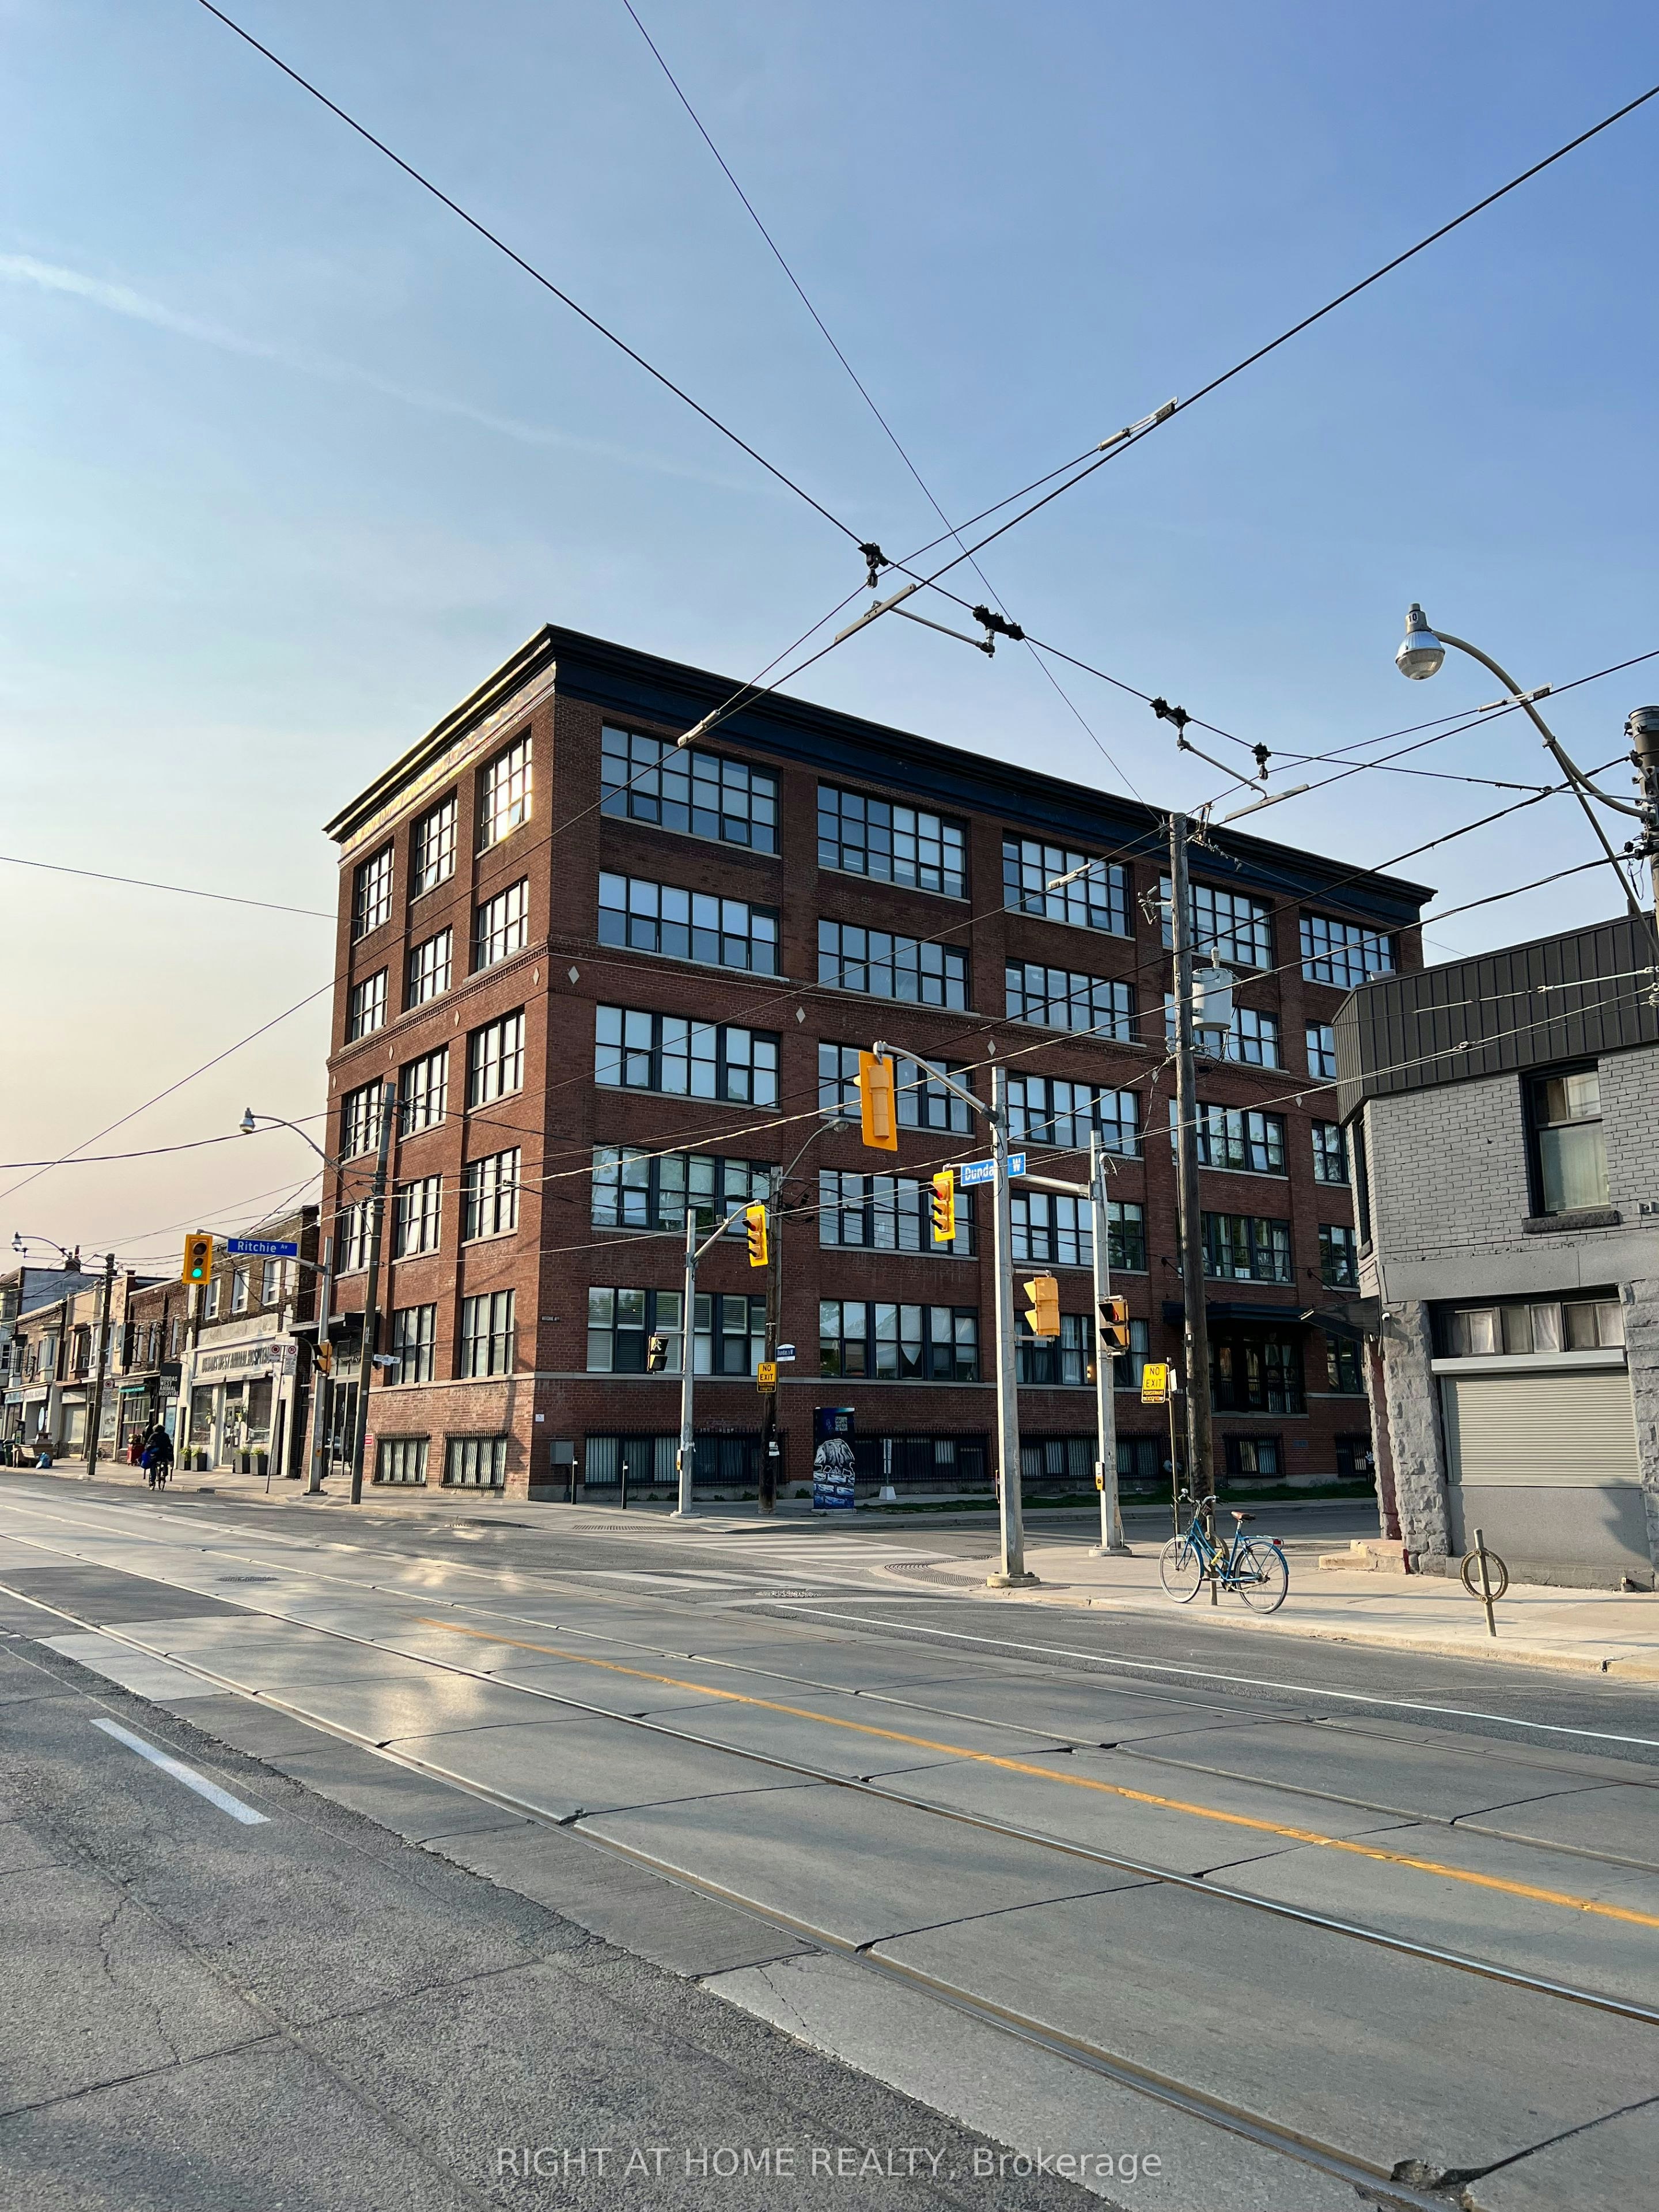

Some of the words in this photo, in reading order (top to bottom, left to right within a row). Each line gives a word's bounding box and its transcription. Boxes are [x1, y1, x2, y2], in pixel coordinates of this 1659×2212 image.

[1408, 613, 1418, 622] 10
[964, 1163, 994, 1181] Dunda
[1012, 1157, 1021, 1172] W
[237, 1240, 276, 1253] Ritchie
[1150, 1366, 1160, 1376] NO
[760, 1373, 774, 1381] EXIT
[1146, 1378, 1162, 1388] EXIT
